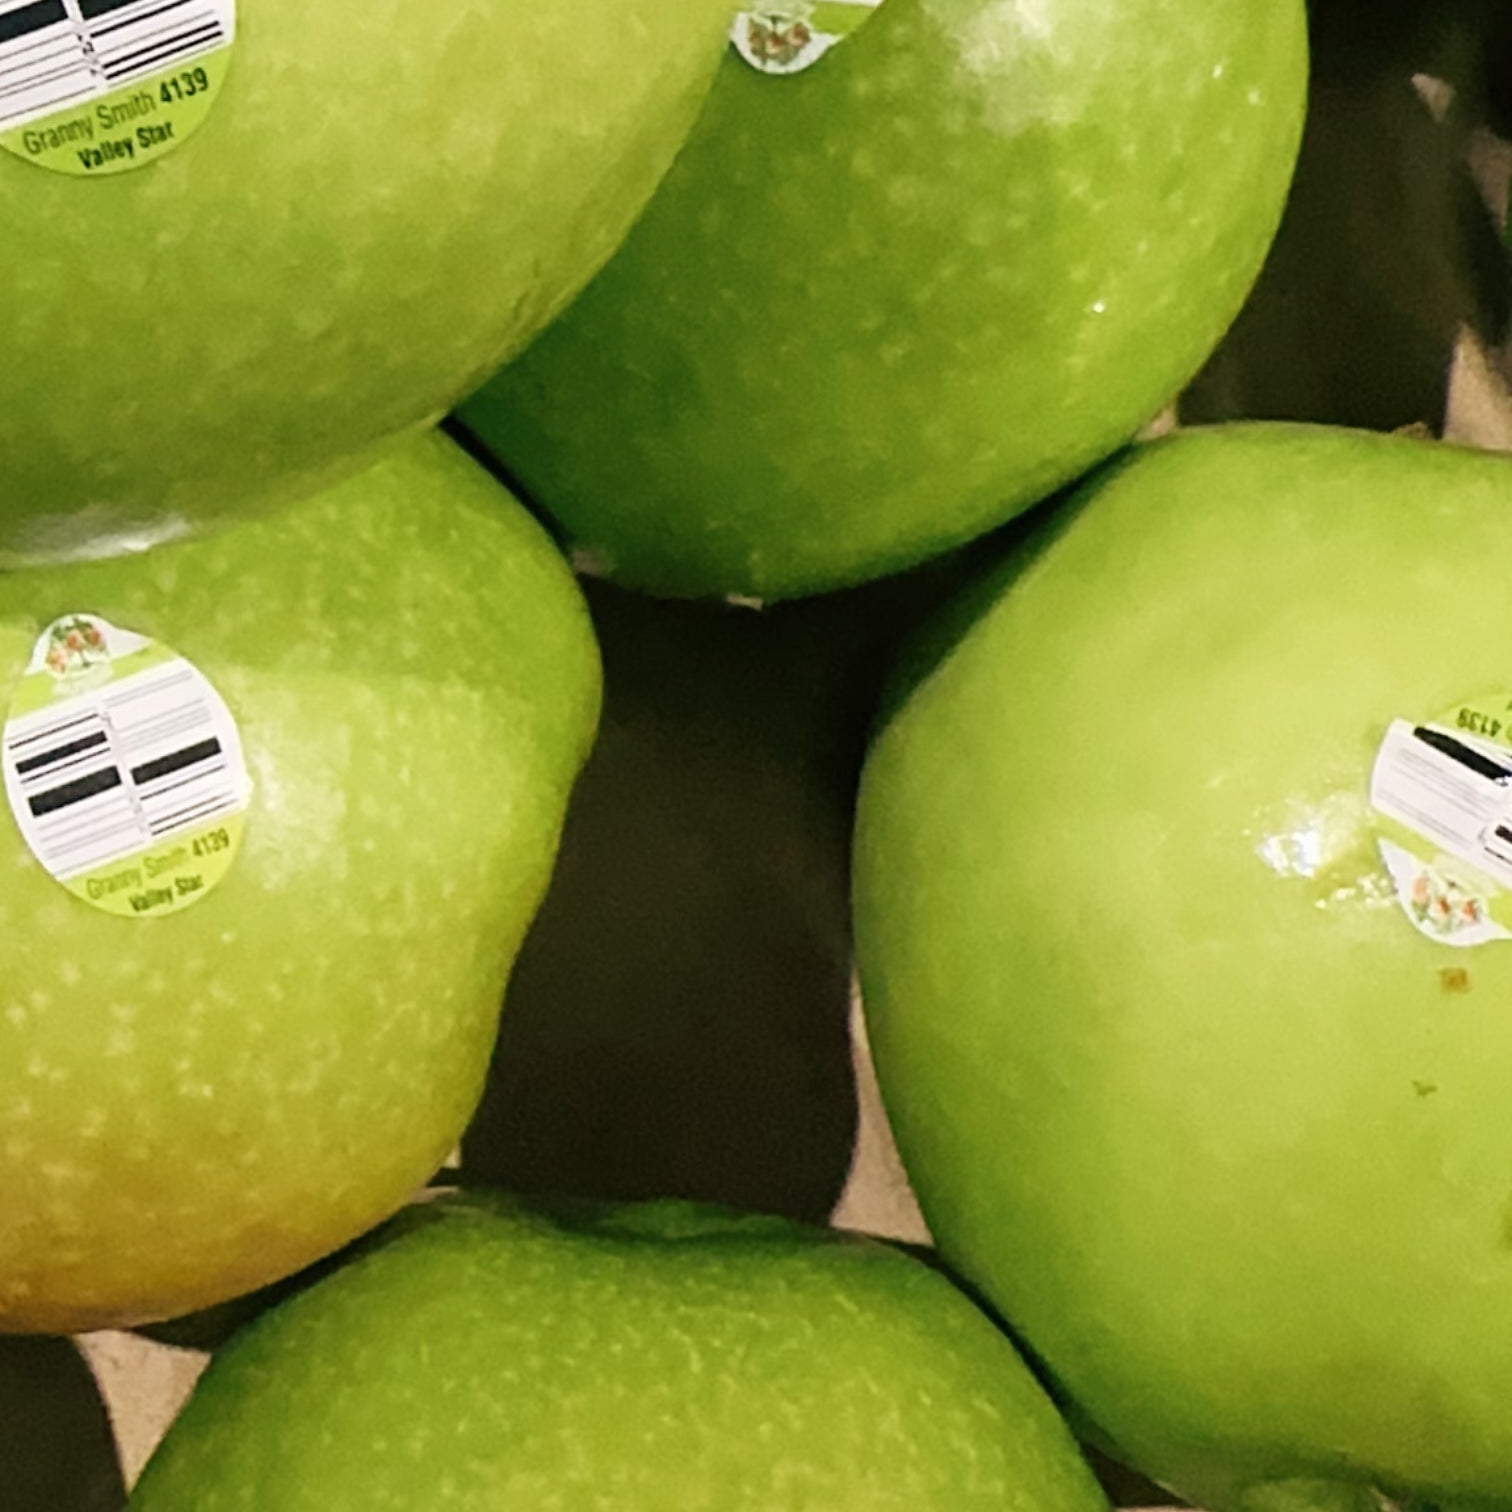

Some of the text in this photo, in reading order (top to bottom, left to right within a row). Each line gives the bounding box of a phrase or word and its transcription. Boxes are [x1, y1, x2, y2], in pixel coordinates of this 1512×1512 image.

[23, 67, 209, 154] Granny Smith 4139
[78, 121, 175, 169] Valley Star
[1457, 708, 1502, 737] 4139
[87, 868, 142, 899] Granny
[193, 828, 229, 856] 4139
[129, 875, 204, 912] Valley Star
